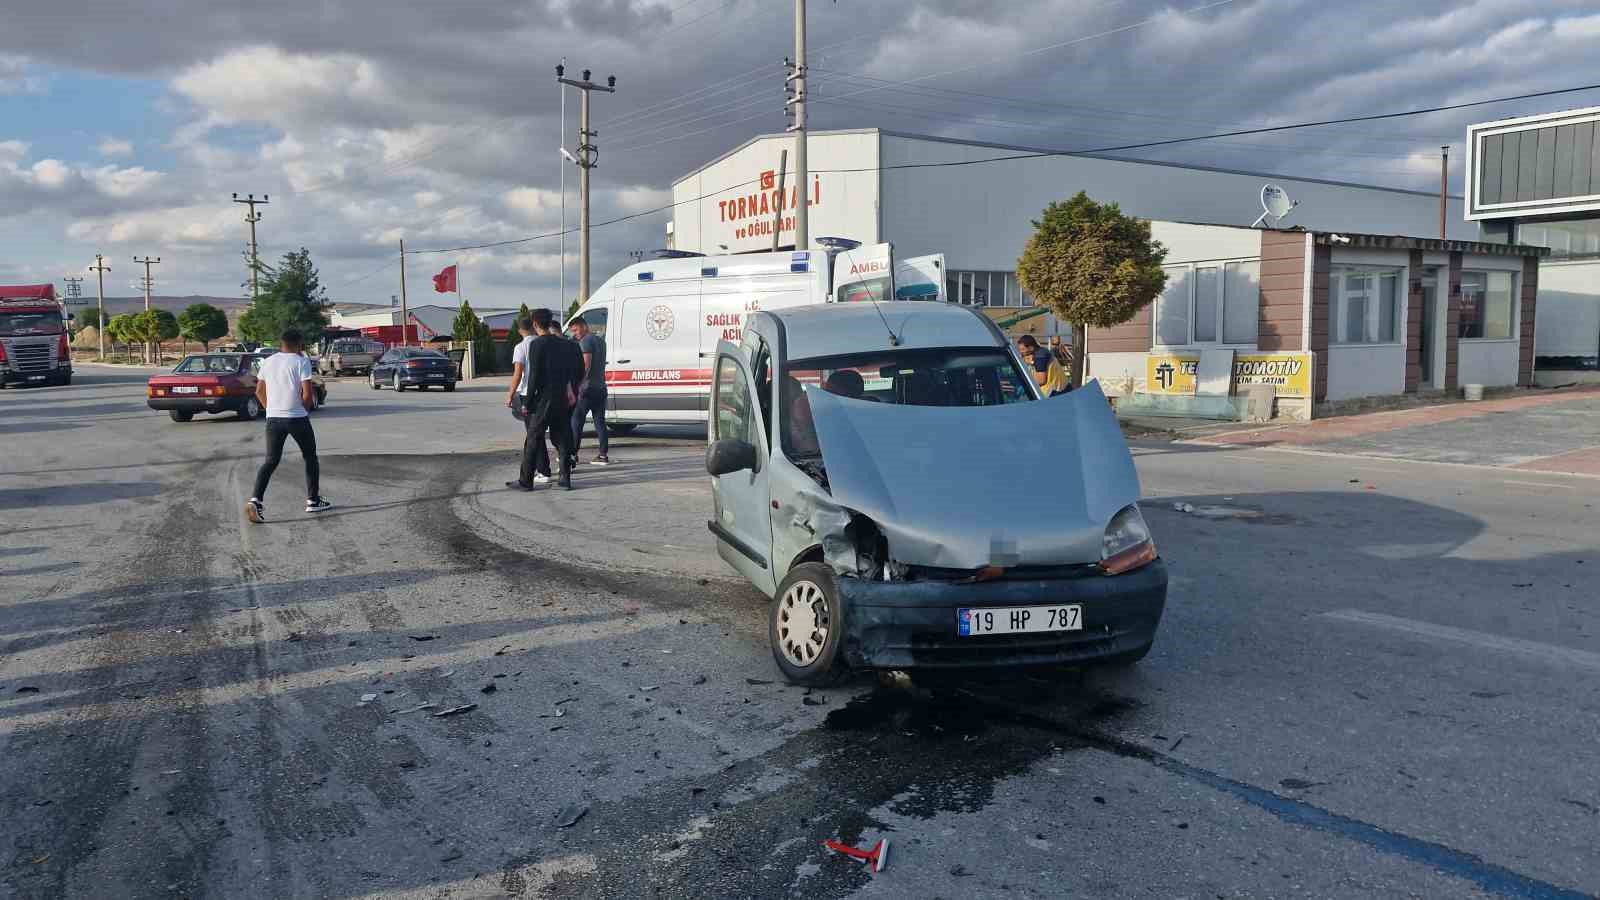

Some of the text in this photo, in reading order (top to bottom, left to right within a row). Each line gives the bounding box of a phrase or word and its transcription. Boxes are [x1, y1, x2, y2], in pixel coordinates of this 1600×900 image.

[706, 312, 741, 327] SAĞLIK
[1233, 356, 1303, 376] TOMOTİV
[631, 370, 681, 380] AMBULANS
[974, 607, 1079, 632] 19 HP 787
